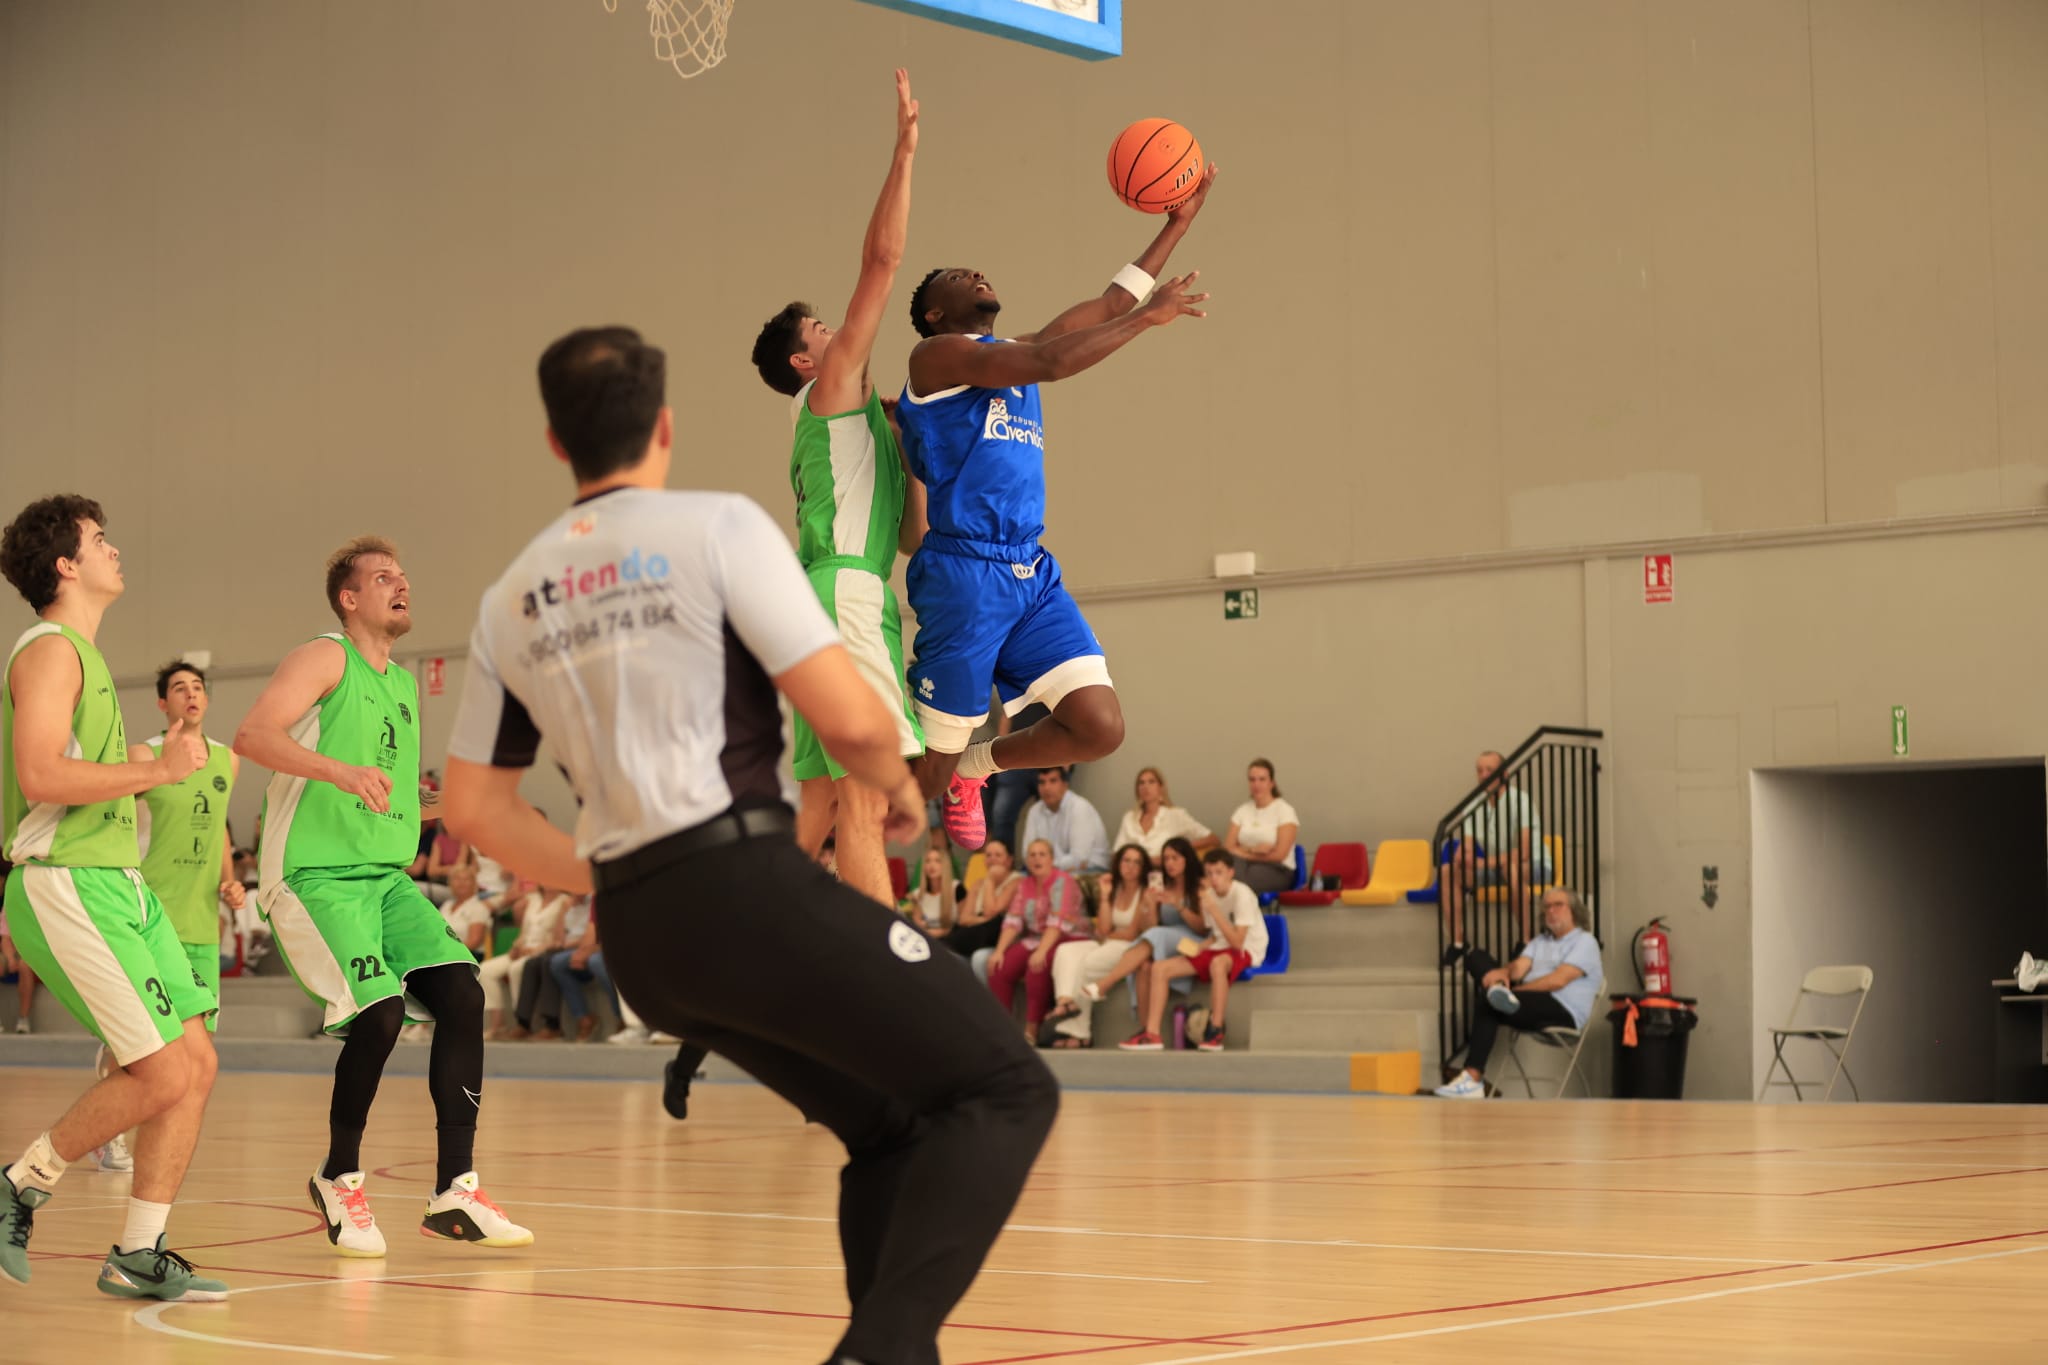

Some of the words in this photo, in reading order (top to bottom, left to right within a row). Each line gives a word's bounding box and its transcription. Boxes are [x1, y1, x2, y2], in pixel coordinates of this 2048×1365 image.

[523, 546, 670, 620] atiendo
[350, 954, 386, 982] 22
[145, 977, 172, 1016] 3
